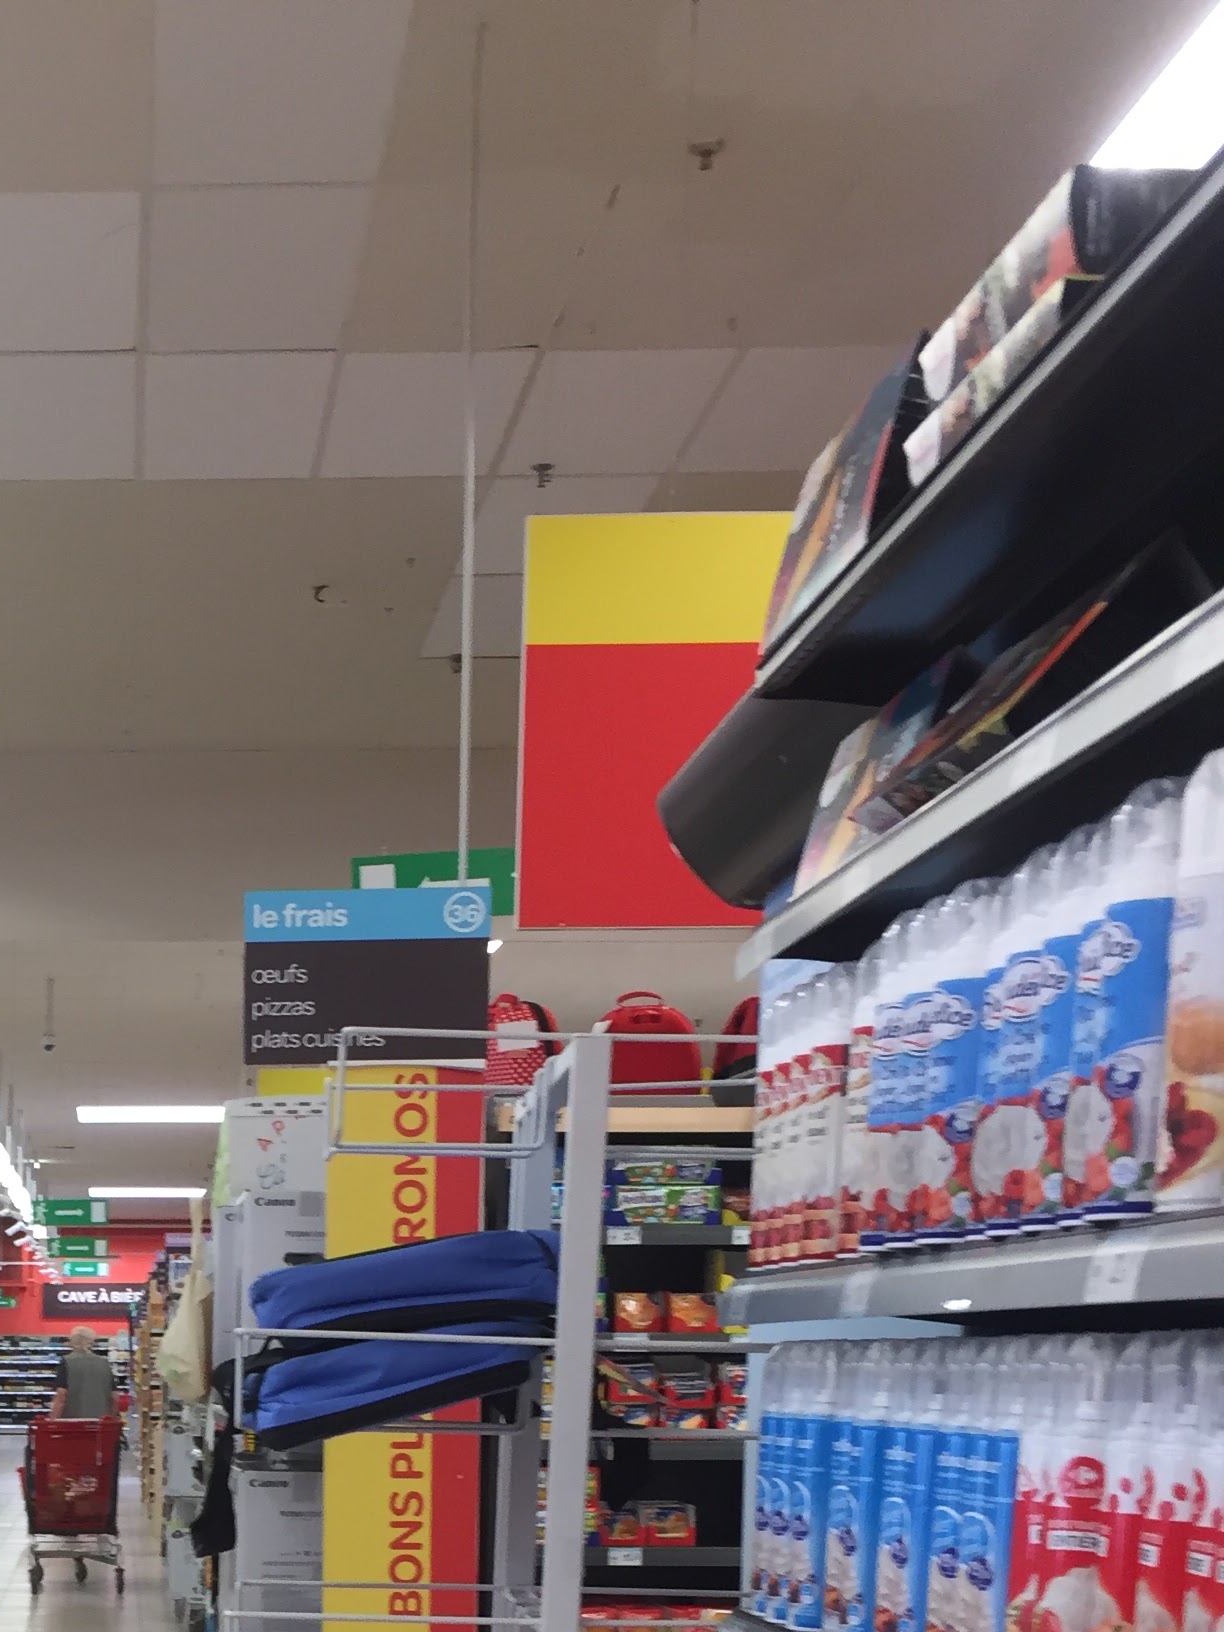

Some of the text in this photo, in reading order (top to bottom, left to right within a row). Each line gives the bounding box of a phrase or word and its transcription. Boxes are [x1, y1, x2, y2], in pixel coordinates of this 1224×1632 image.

[252, 902, 348, 928] le frais
[450, 903, 480, 924] 36
[251, 963, 309, 984] œufs
[251, 997, 316, 1020] pizzas
[251, 1030, 301, 1053] plats
[254, 1196, 296, 1207] Canon
[57, 1290, 98, 1303] CAVE
[97, 1287, 110, 1303] À
[389, 1490, 425, 1616] BONS
